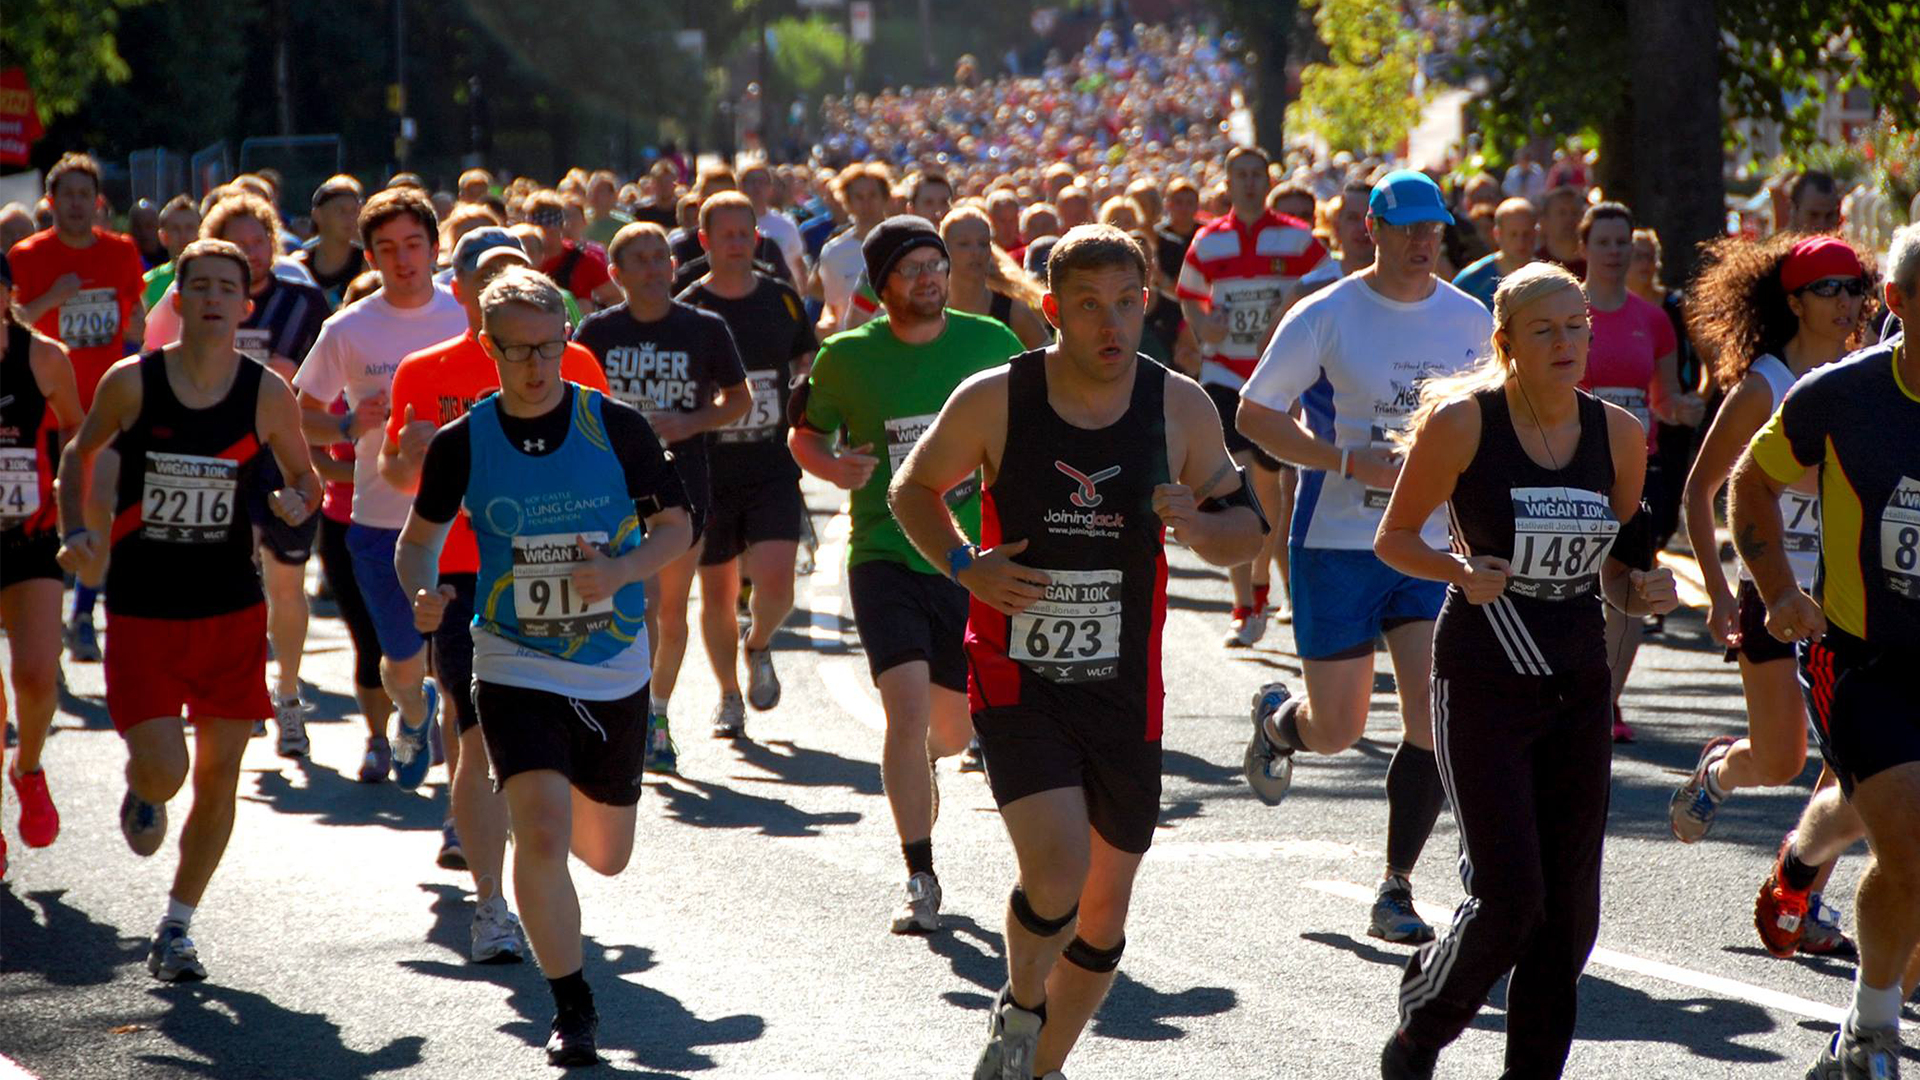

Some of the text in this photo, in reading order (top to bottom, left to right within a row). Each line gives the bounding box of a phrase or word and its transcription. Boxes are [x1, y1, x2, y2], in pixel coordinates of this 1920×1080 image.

[62, 311, 115, 334] 2206
[605, 349, 690, 380] SUPER
[203, 465, 229, 478] 10K
[147, 488, 229, 523] 2216
[525, 495, 611, 517] LUNG CANCER
[1580, 504, 1607, 519] 10K
[1520, 536, 1614, 577] 1487
[529, 579, 589, 616] 91
[1082, 586, 1110, 601] 10K
[1026, 618, 1102, 658] 623
[1087, 666, 1113, 677] WLCT
